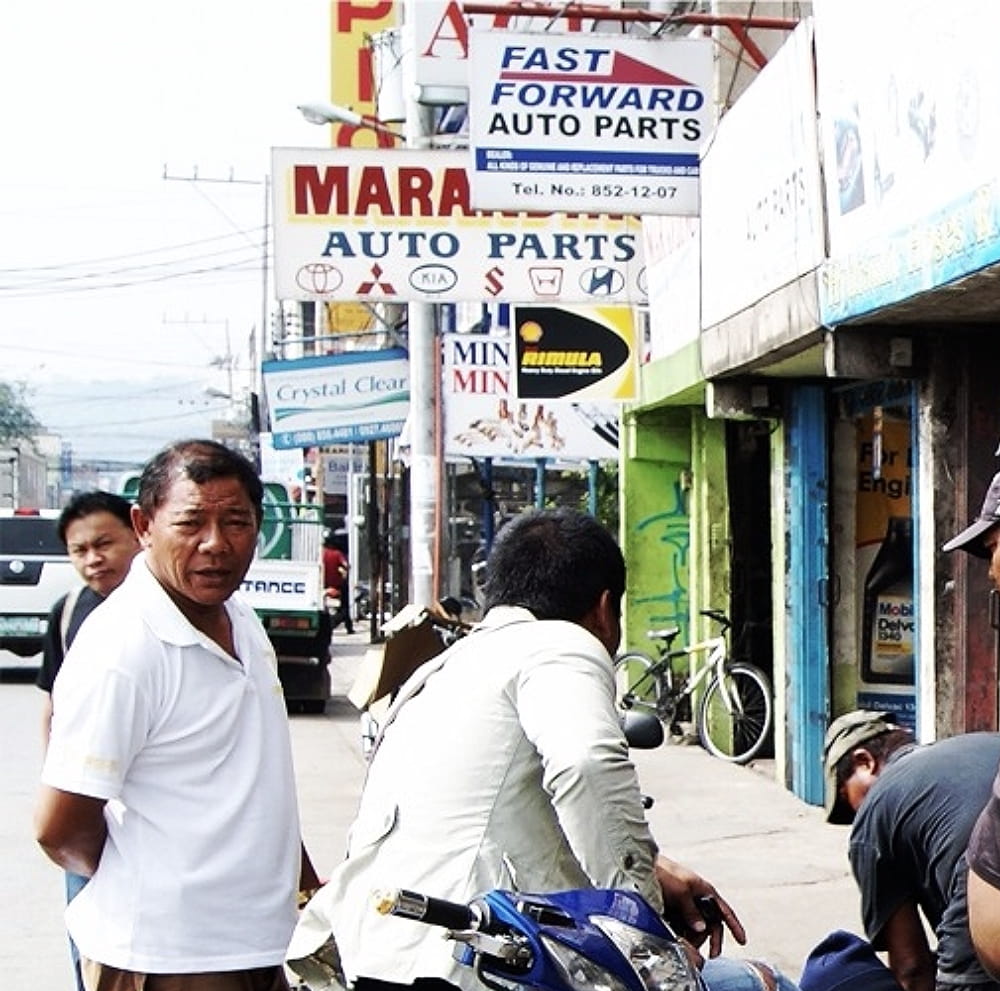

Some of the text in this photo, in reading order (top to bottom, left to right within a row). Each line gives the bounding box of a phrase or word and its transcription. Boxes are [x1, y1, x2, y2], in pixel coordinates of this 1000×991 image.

[501, 45, 610, 72] FAST
[491, 82, 705, 113] FORWARD
[488, 112, 702, 141] AUTO PARTS
[512, 182, 544, 196] Tel.
[592, 184, 678, 198] 852-12-07
[321, 231, 459, 259] AUTO
[487, 232, 637, 263] PARTS
[420, 273, 449, 285] KIA
[453, 340, 510, 366] MIN
[521, 351, 602, 367] RIMULA
[276, 375, 407, 405] Crystal Clear
[453, 369, 510, 394] MIN
[860, 441, 899, 466] For
